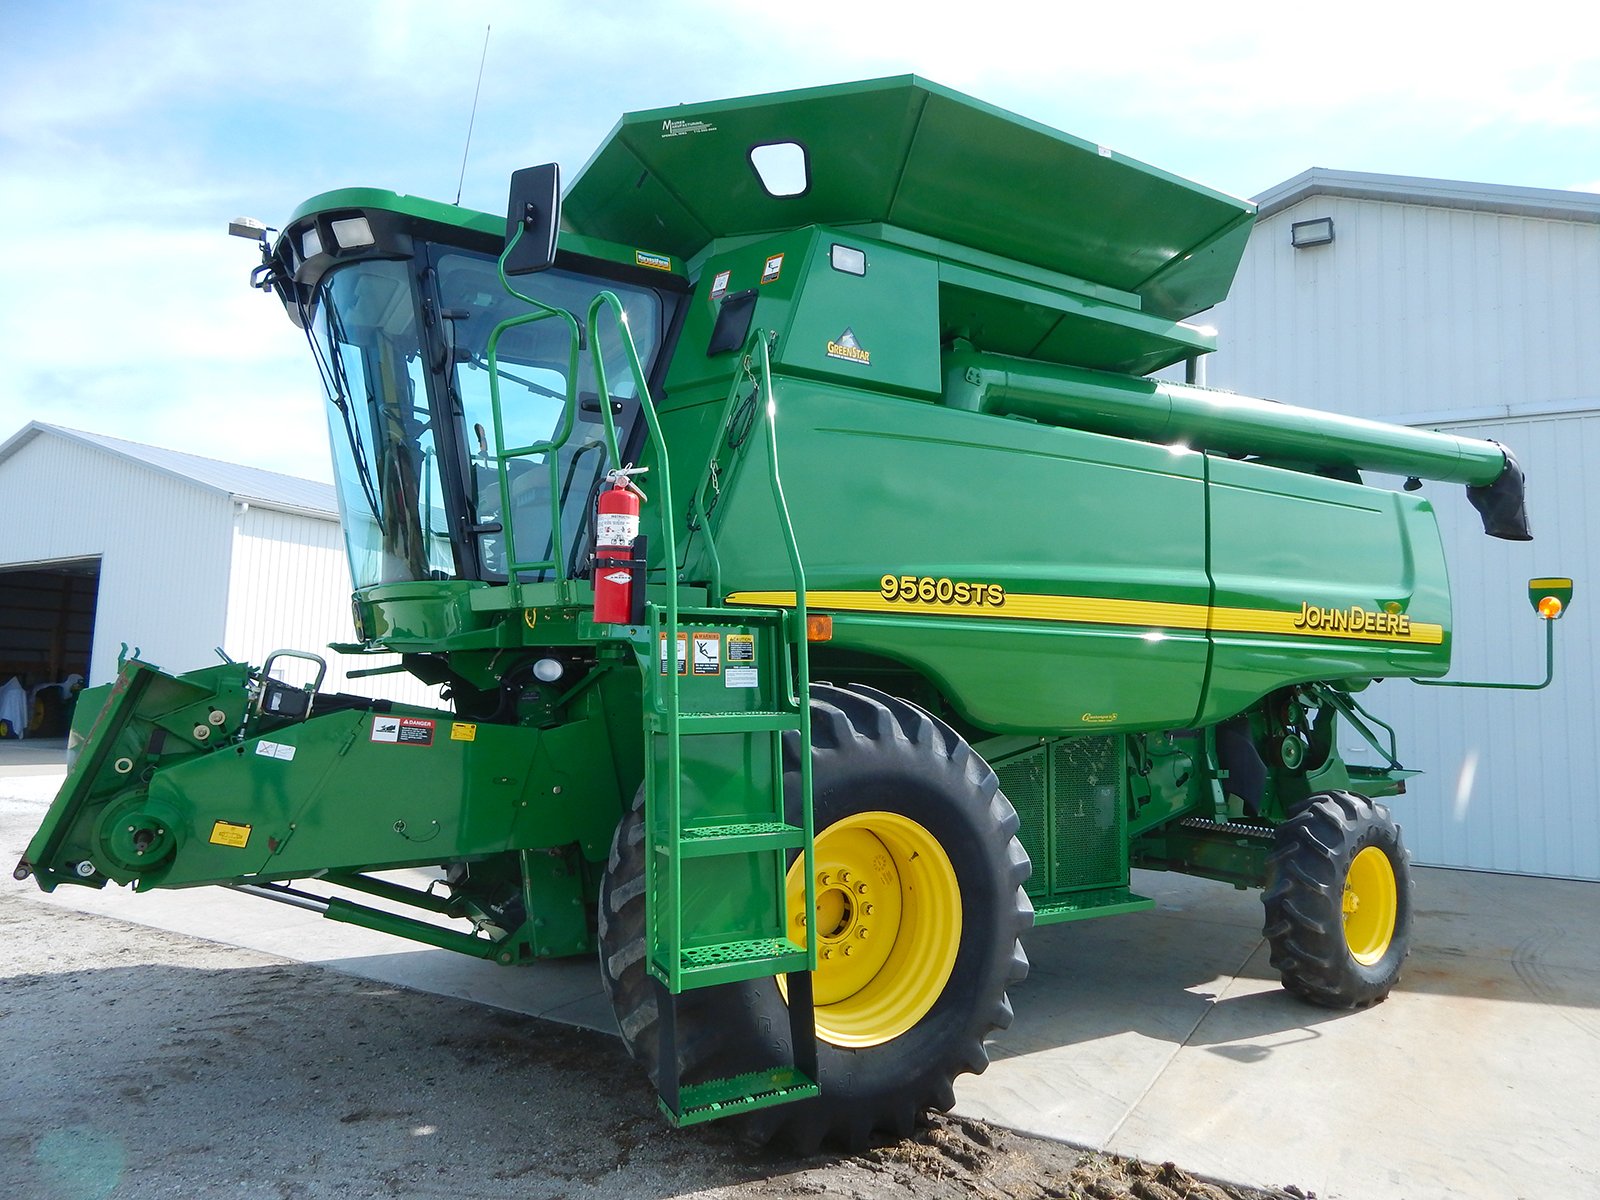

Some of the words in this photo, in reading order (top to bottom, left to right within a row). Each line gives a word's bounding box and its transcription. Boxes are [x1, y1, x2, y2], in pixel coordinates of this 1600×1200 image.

[827, 340, 870, 361] GREENSTAR
[880, 574, 1005, 607] 9560STS
[1294, 601, 1349, 630] JOHN
[1350, 605, 1410, 637] DEERE
